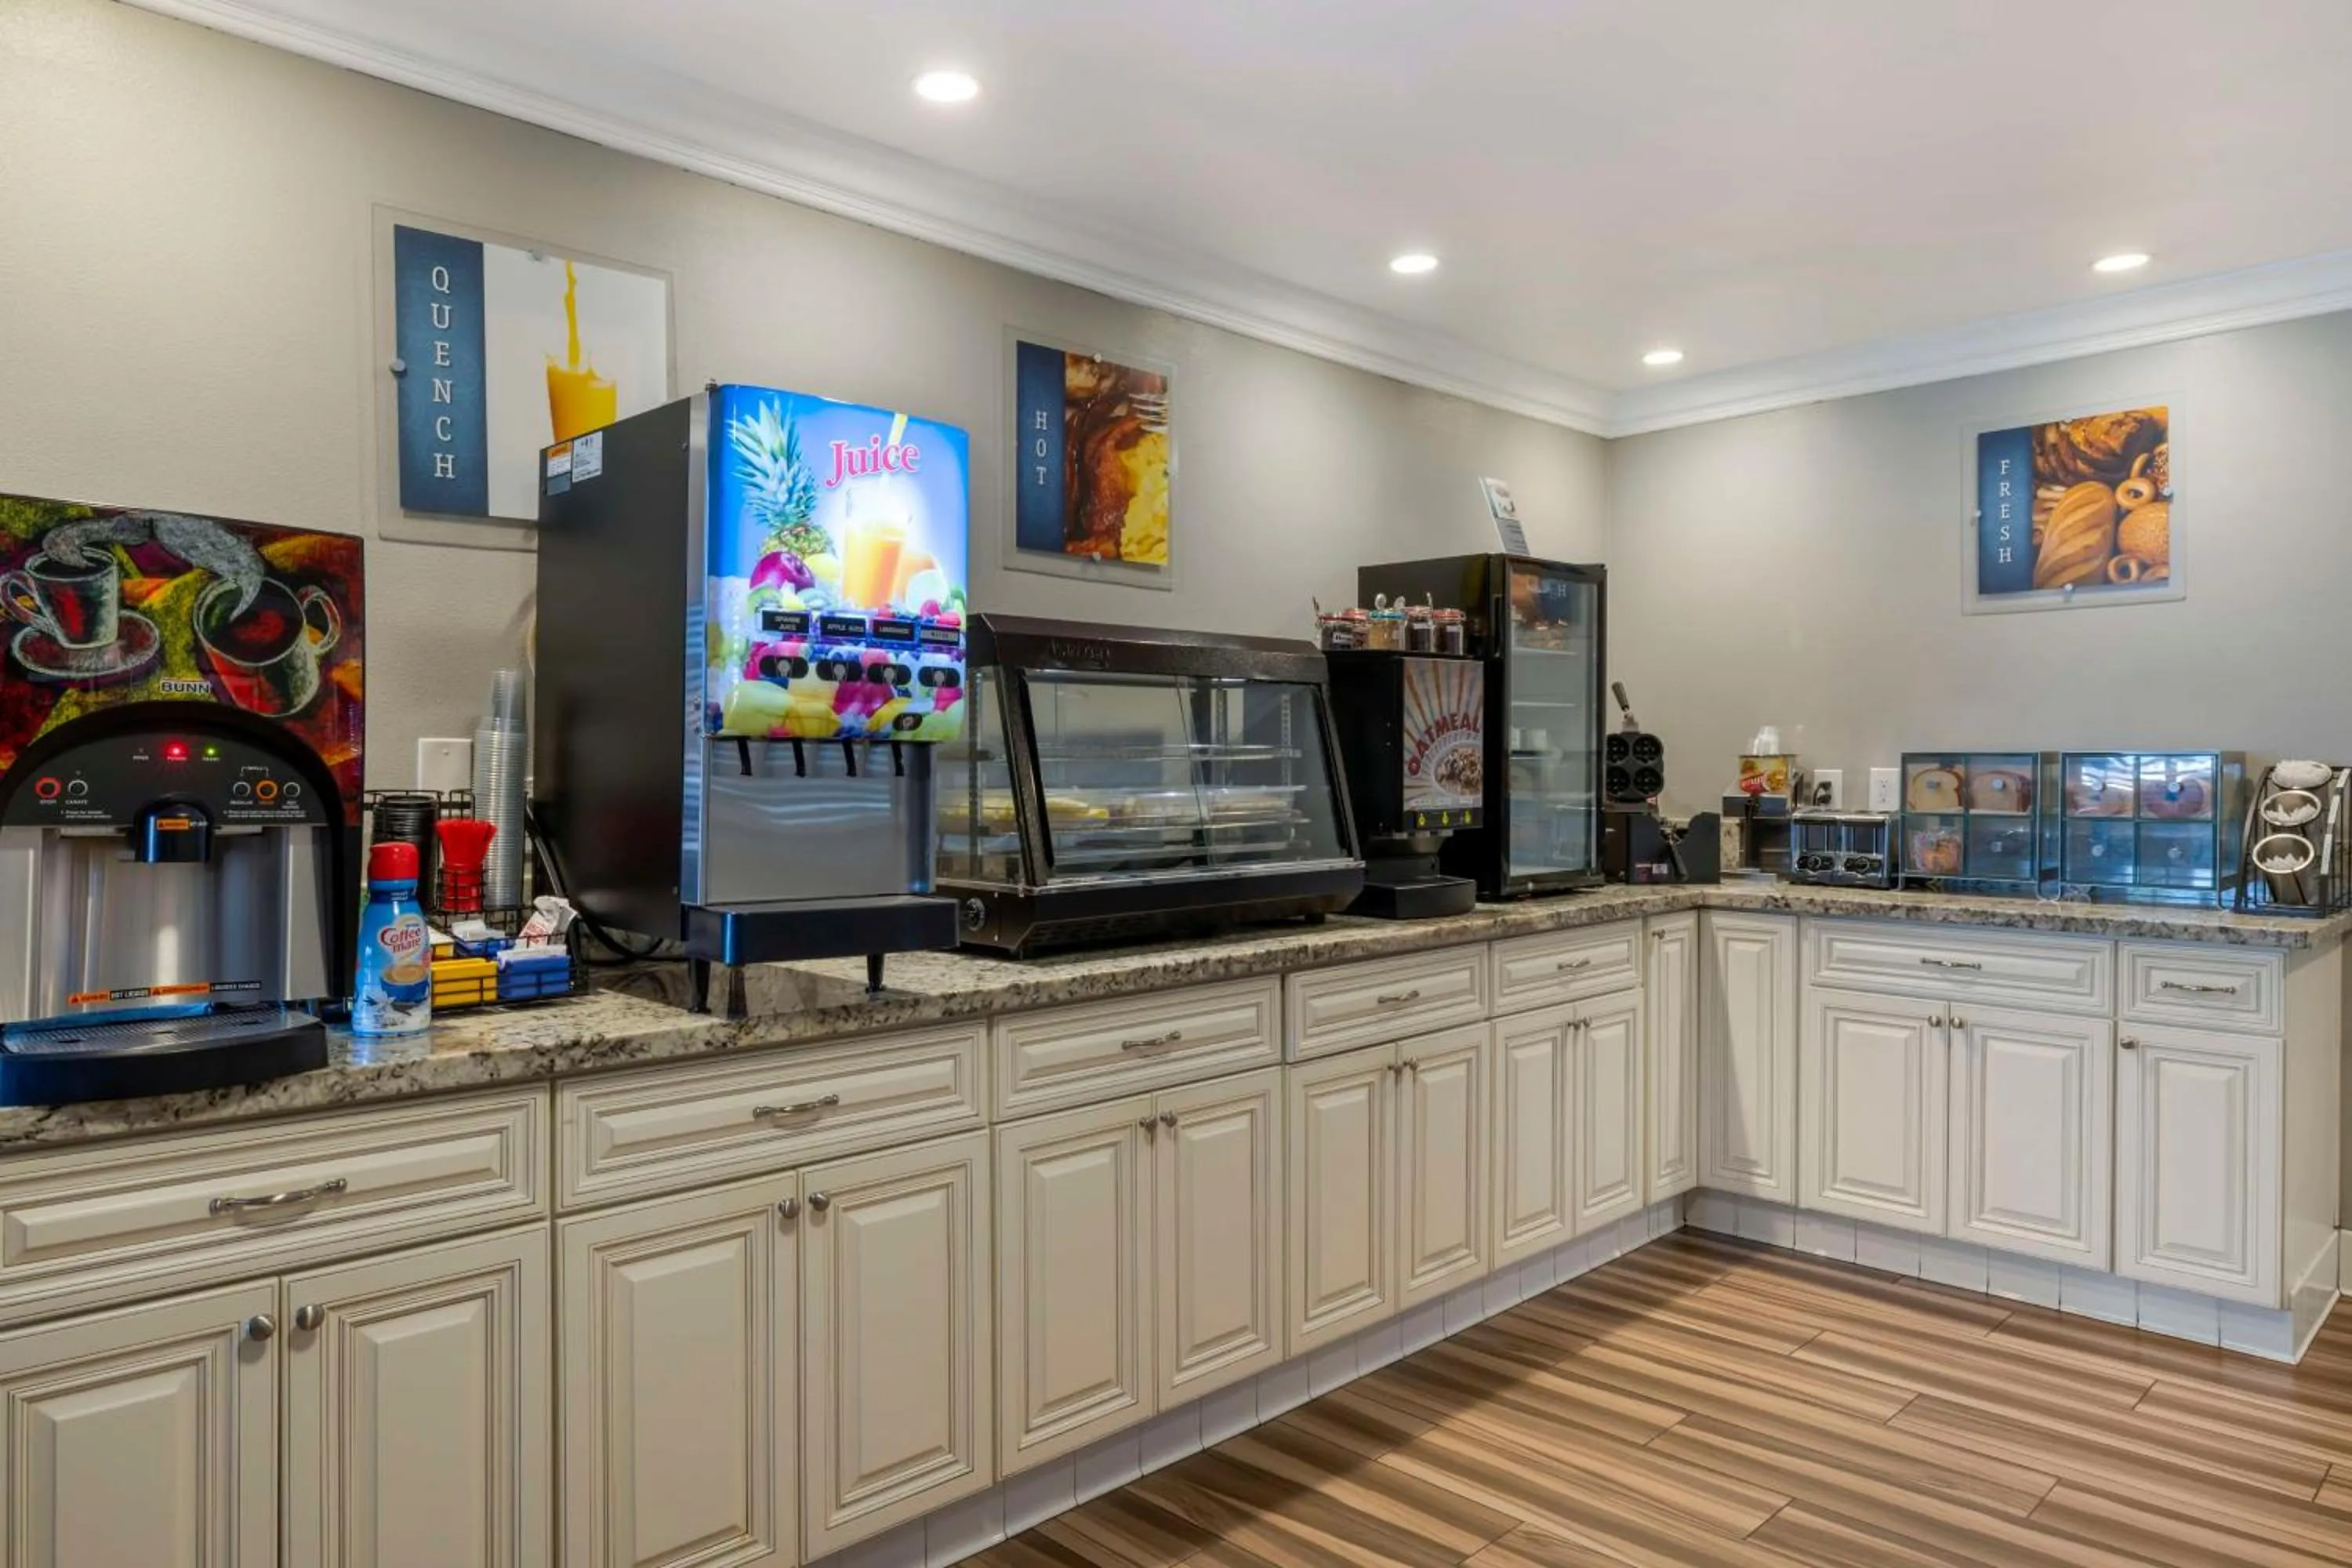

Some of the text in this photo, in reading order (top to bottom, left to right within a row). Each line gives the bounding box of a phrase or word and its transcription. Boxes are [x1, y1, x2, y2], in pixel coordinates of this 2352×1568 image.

[430, 267, 456, 479] QUENCH
[826, 436, 919, 487] Juice
[1035, 411, 1047, 485] HOT
[1998, 459, 2012, 562] FRESH
[162, 681, 210, 694] BUNN
[1407, 711, 1481, 777] OATMEAL
[379, 927, 421, 946] Coffee
